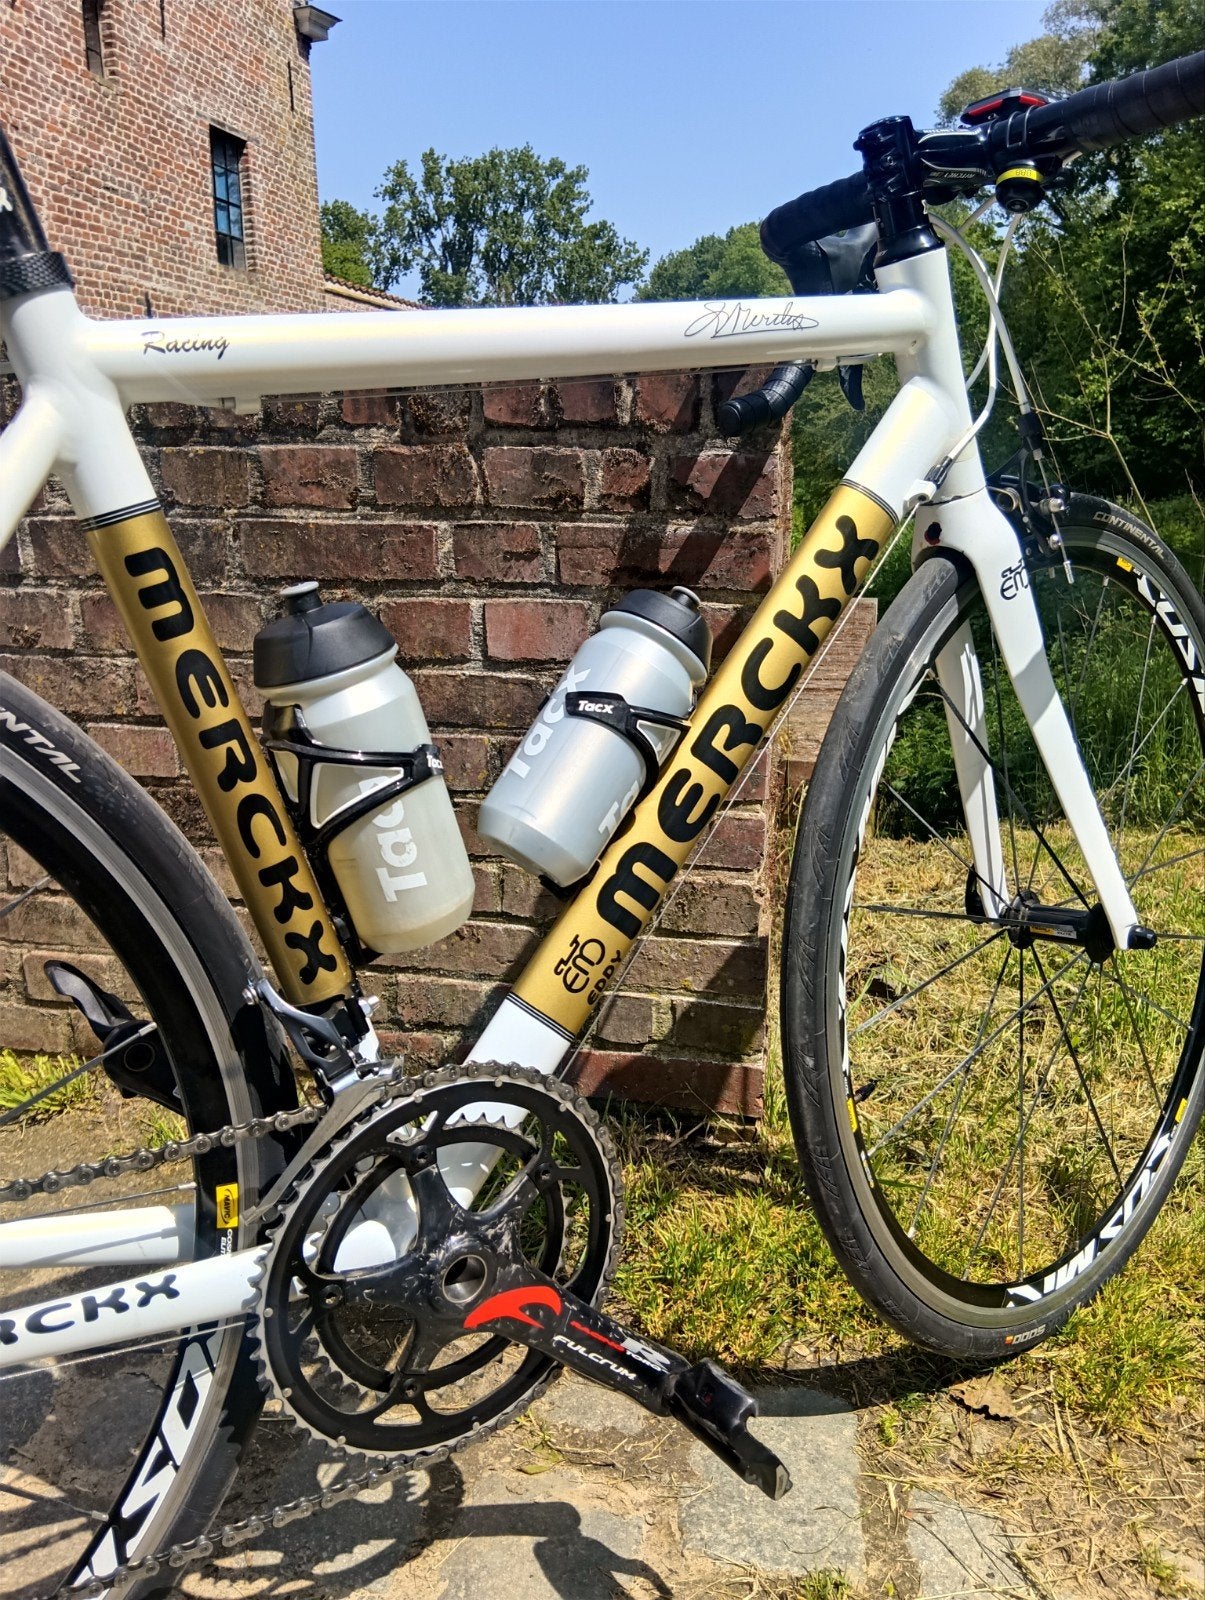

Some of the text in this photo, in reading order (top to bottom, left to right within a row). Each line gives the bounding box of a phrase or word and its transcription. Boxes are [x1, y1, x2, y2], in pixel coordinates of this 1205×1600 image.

[141, 331, 230, 359] Racing
[1093, 511, 1165, 560] CONTINENTAL
[579, 701, 614, 714] Tacx
[597, 515, 879, 940] MERCKX
[124, 547, 337, 985] MERCKX
[359, 776, 428, 902] Tac
[587, 950, 621, 1005] EDDY
[553, 1334, 637, 1380] FULCRUM
